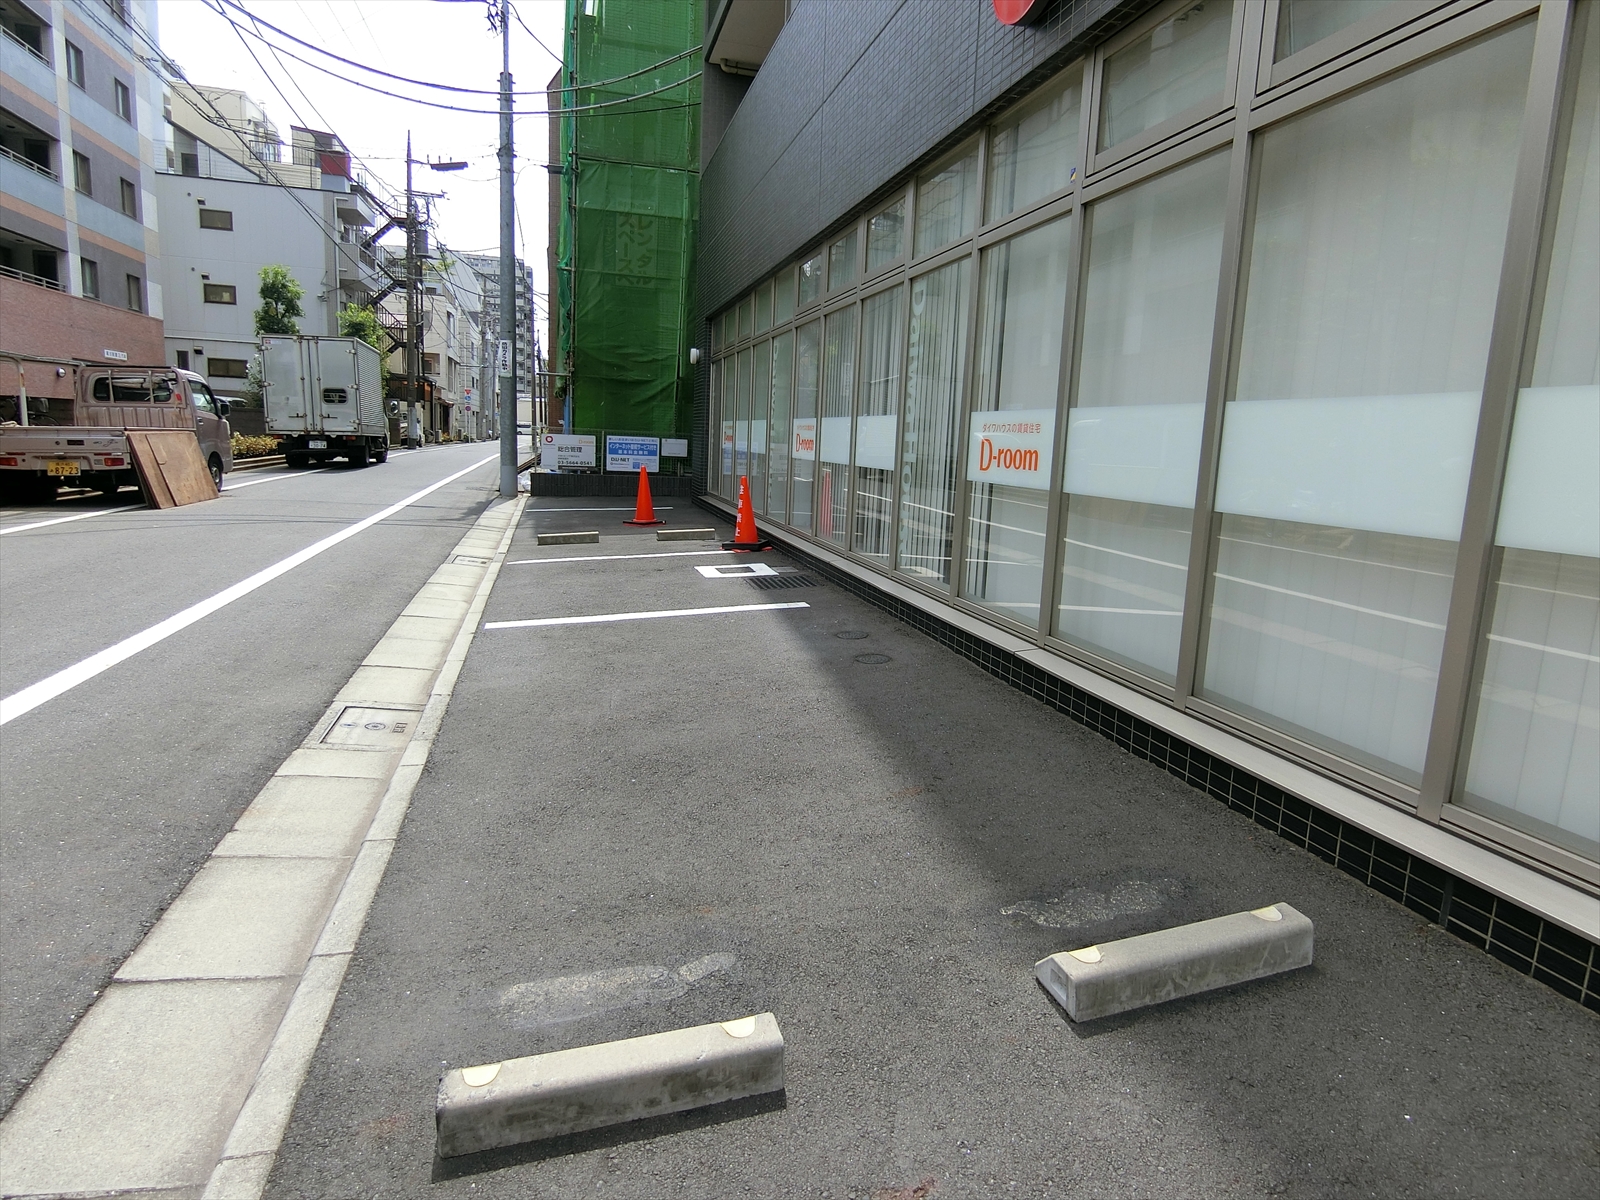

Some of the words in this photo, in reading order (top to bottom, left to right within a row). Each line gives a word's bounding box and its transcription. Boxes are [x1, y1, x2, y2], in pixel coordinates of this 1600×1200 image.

[982, 423, 1041, 434] ダイワハウスの賃貸住宅
[979, 438, 1039, 471] D-room
